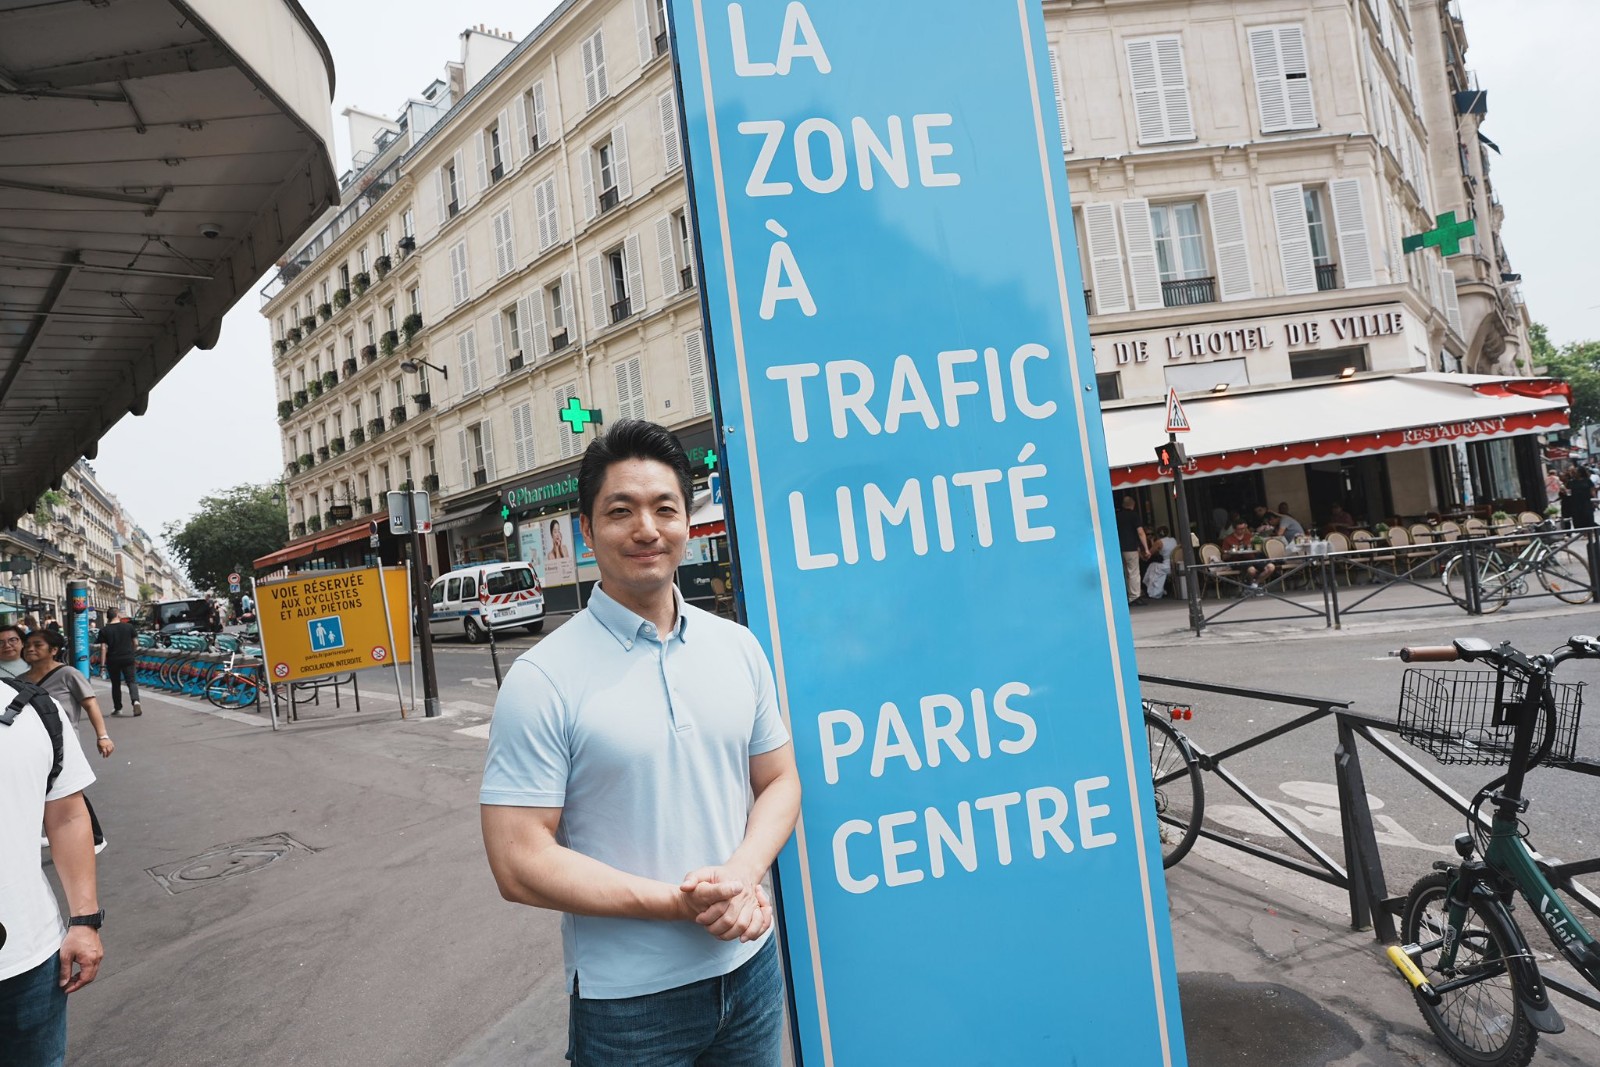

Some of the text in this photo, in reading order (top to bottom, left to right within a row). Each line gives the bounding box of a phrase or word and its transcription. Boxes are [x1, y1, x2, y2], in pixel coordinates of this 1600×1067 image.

[727, 1, 832, 77] LA
[737, 113, 961, 197] ZONE
[759, 219, 817, 320] À
[1114, 340, 1149, 365] DE
[1167, 325, 1274, 359] L'HOTEL
[1285, 321, 1321, 346] DE
[1331, 312, 1405, 340] VILLE
[766, 343, 1057, 443] TRAFIC
[1402, 419, 1506, 443] RESTAURANT
[516, 474, 579, 506] Pharmacie
[789, 442, 1055, 570] LIMITÉ
[271, 574, 364, 600] VOIE RÉSERVÉE
[280, 599, 363, 621] ET AUX PIÉTONS
[281, 588, 359, 610] AUX CYCLISTES
[300, 657, 362, 673] CIRCULATION INTERDITE
[818, 681, 1037, 784] PARIS
[832, 776, 1117, 894] CENTRE
